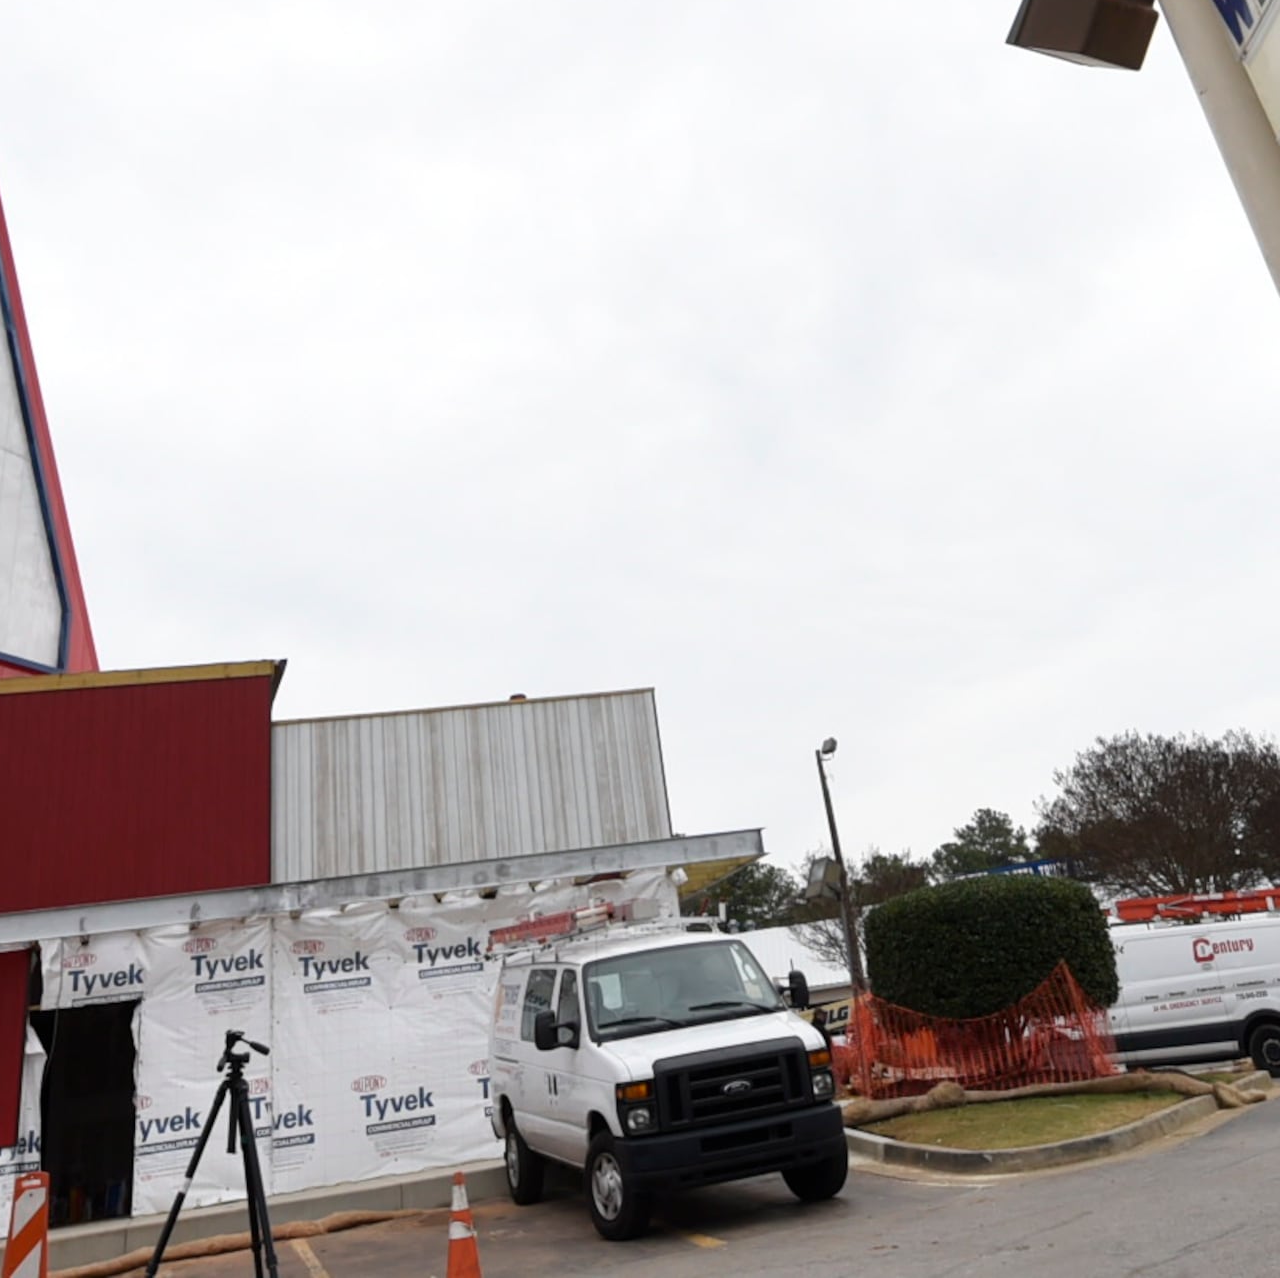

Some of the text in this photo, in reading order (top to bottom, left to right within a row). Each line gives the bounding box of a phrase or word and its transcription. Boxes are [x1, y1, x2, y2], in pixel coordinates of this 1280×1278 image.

[190, 948, 265, 980] Tyvek
[298, 951, 370, 980] Tyvek
[412, 936, 482, 966] Tyvek
[1193, 937, 1254, 963] Century
[68, 963, 145, 995] Tyvek
[359, 1086, 435, 1121] Tyvek
